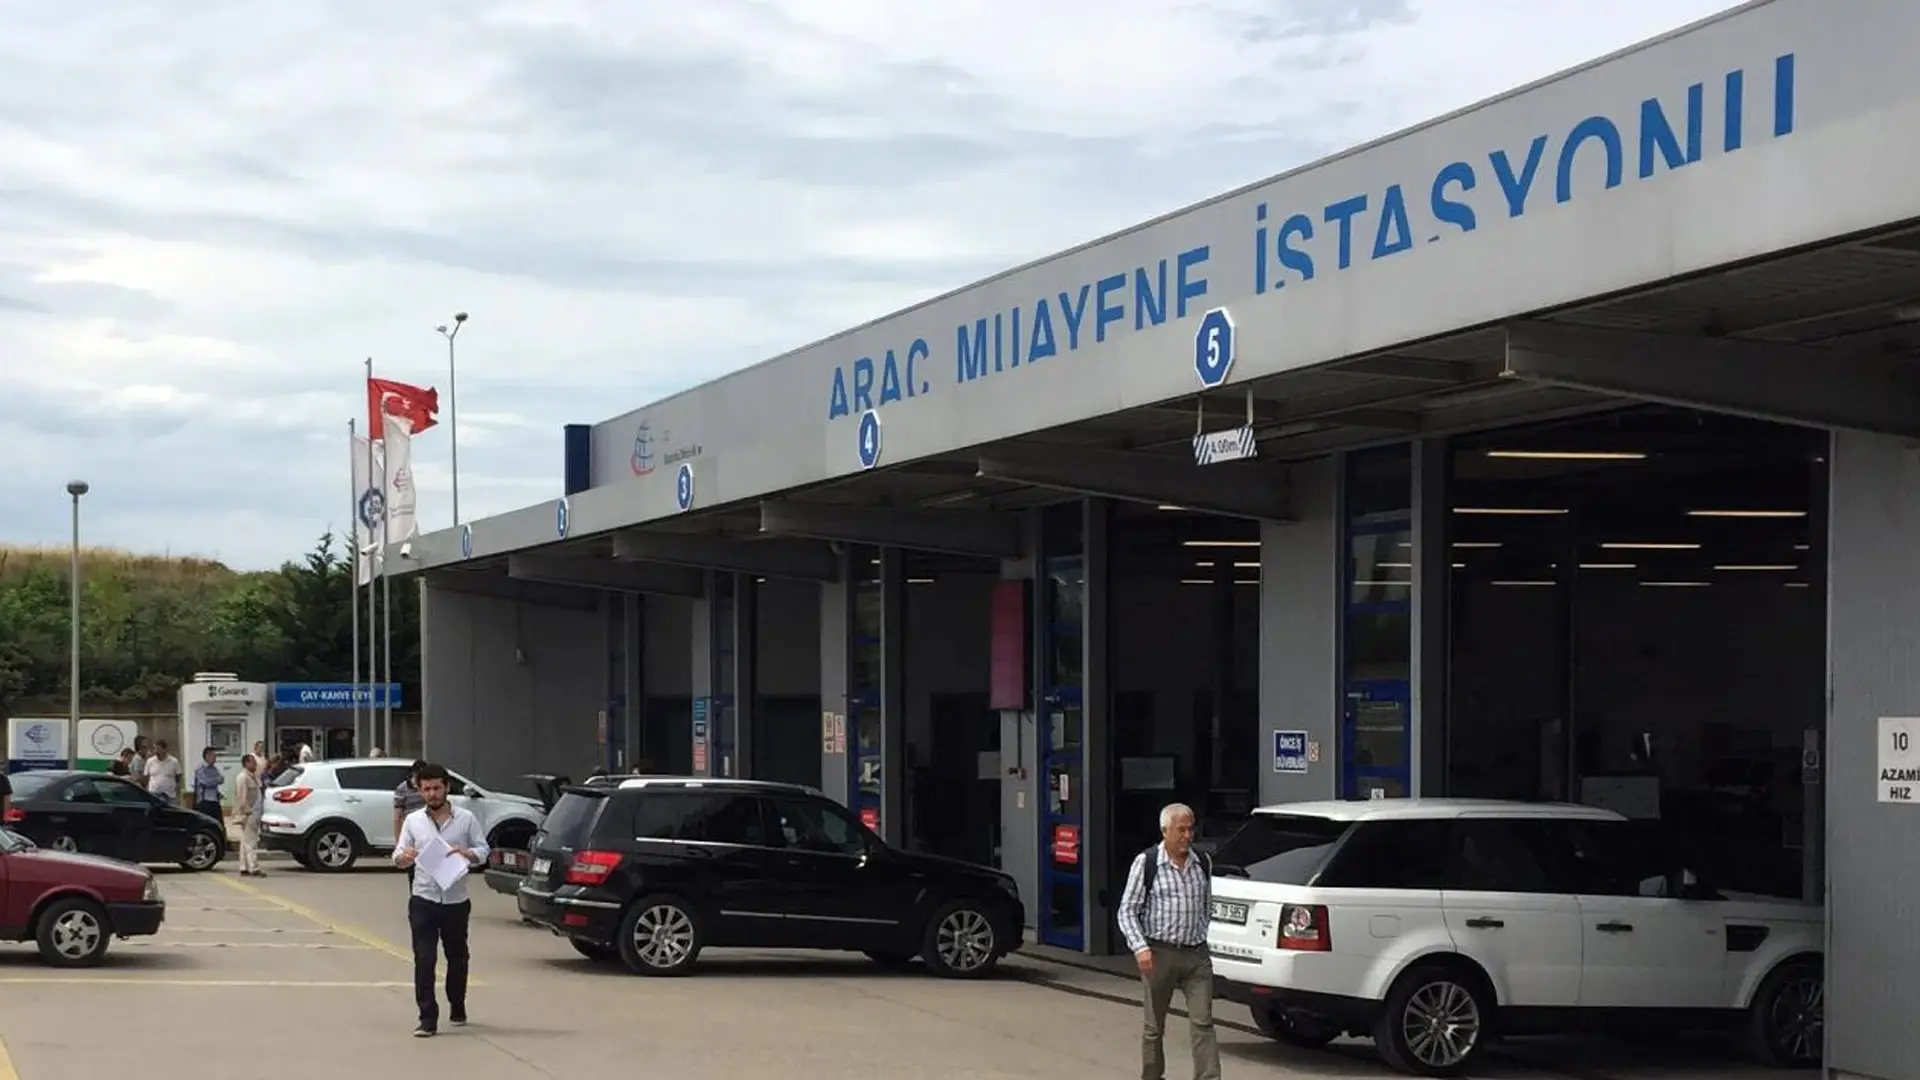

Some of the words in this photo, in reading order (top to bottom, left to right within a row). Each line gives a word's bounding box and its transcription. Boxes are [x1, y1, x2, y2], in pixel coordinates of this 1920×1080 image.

[1206, 328, 1221, 368] 5
[864, 429, 874, 454] 4
[1892, 732, 1909, 751] 10
[1890, 786, 1912, 800] HIZ
